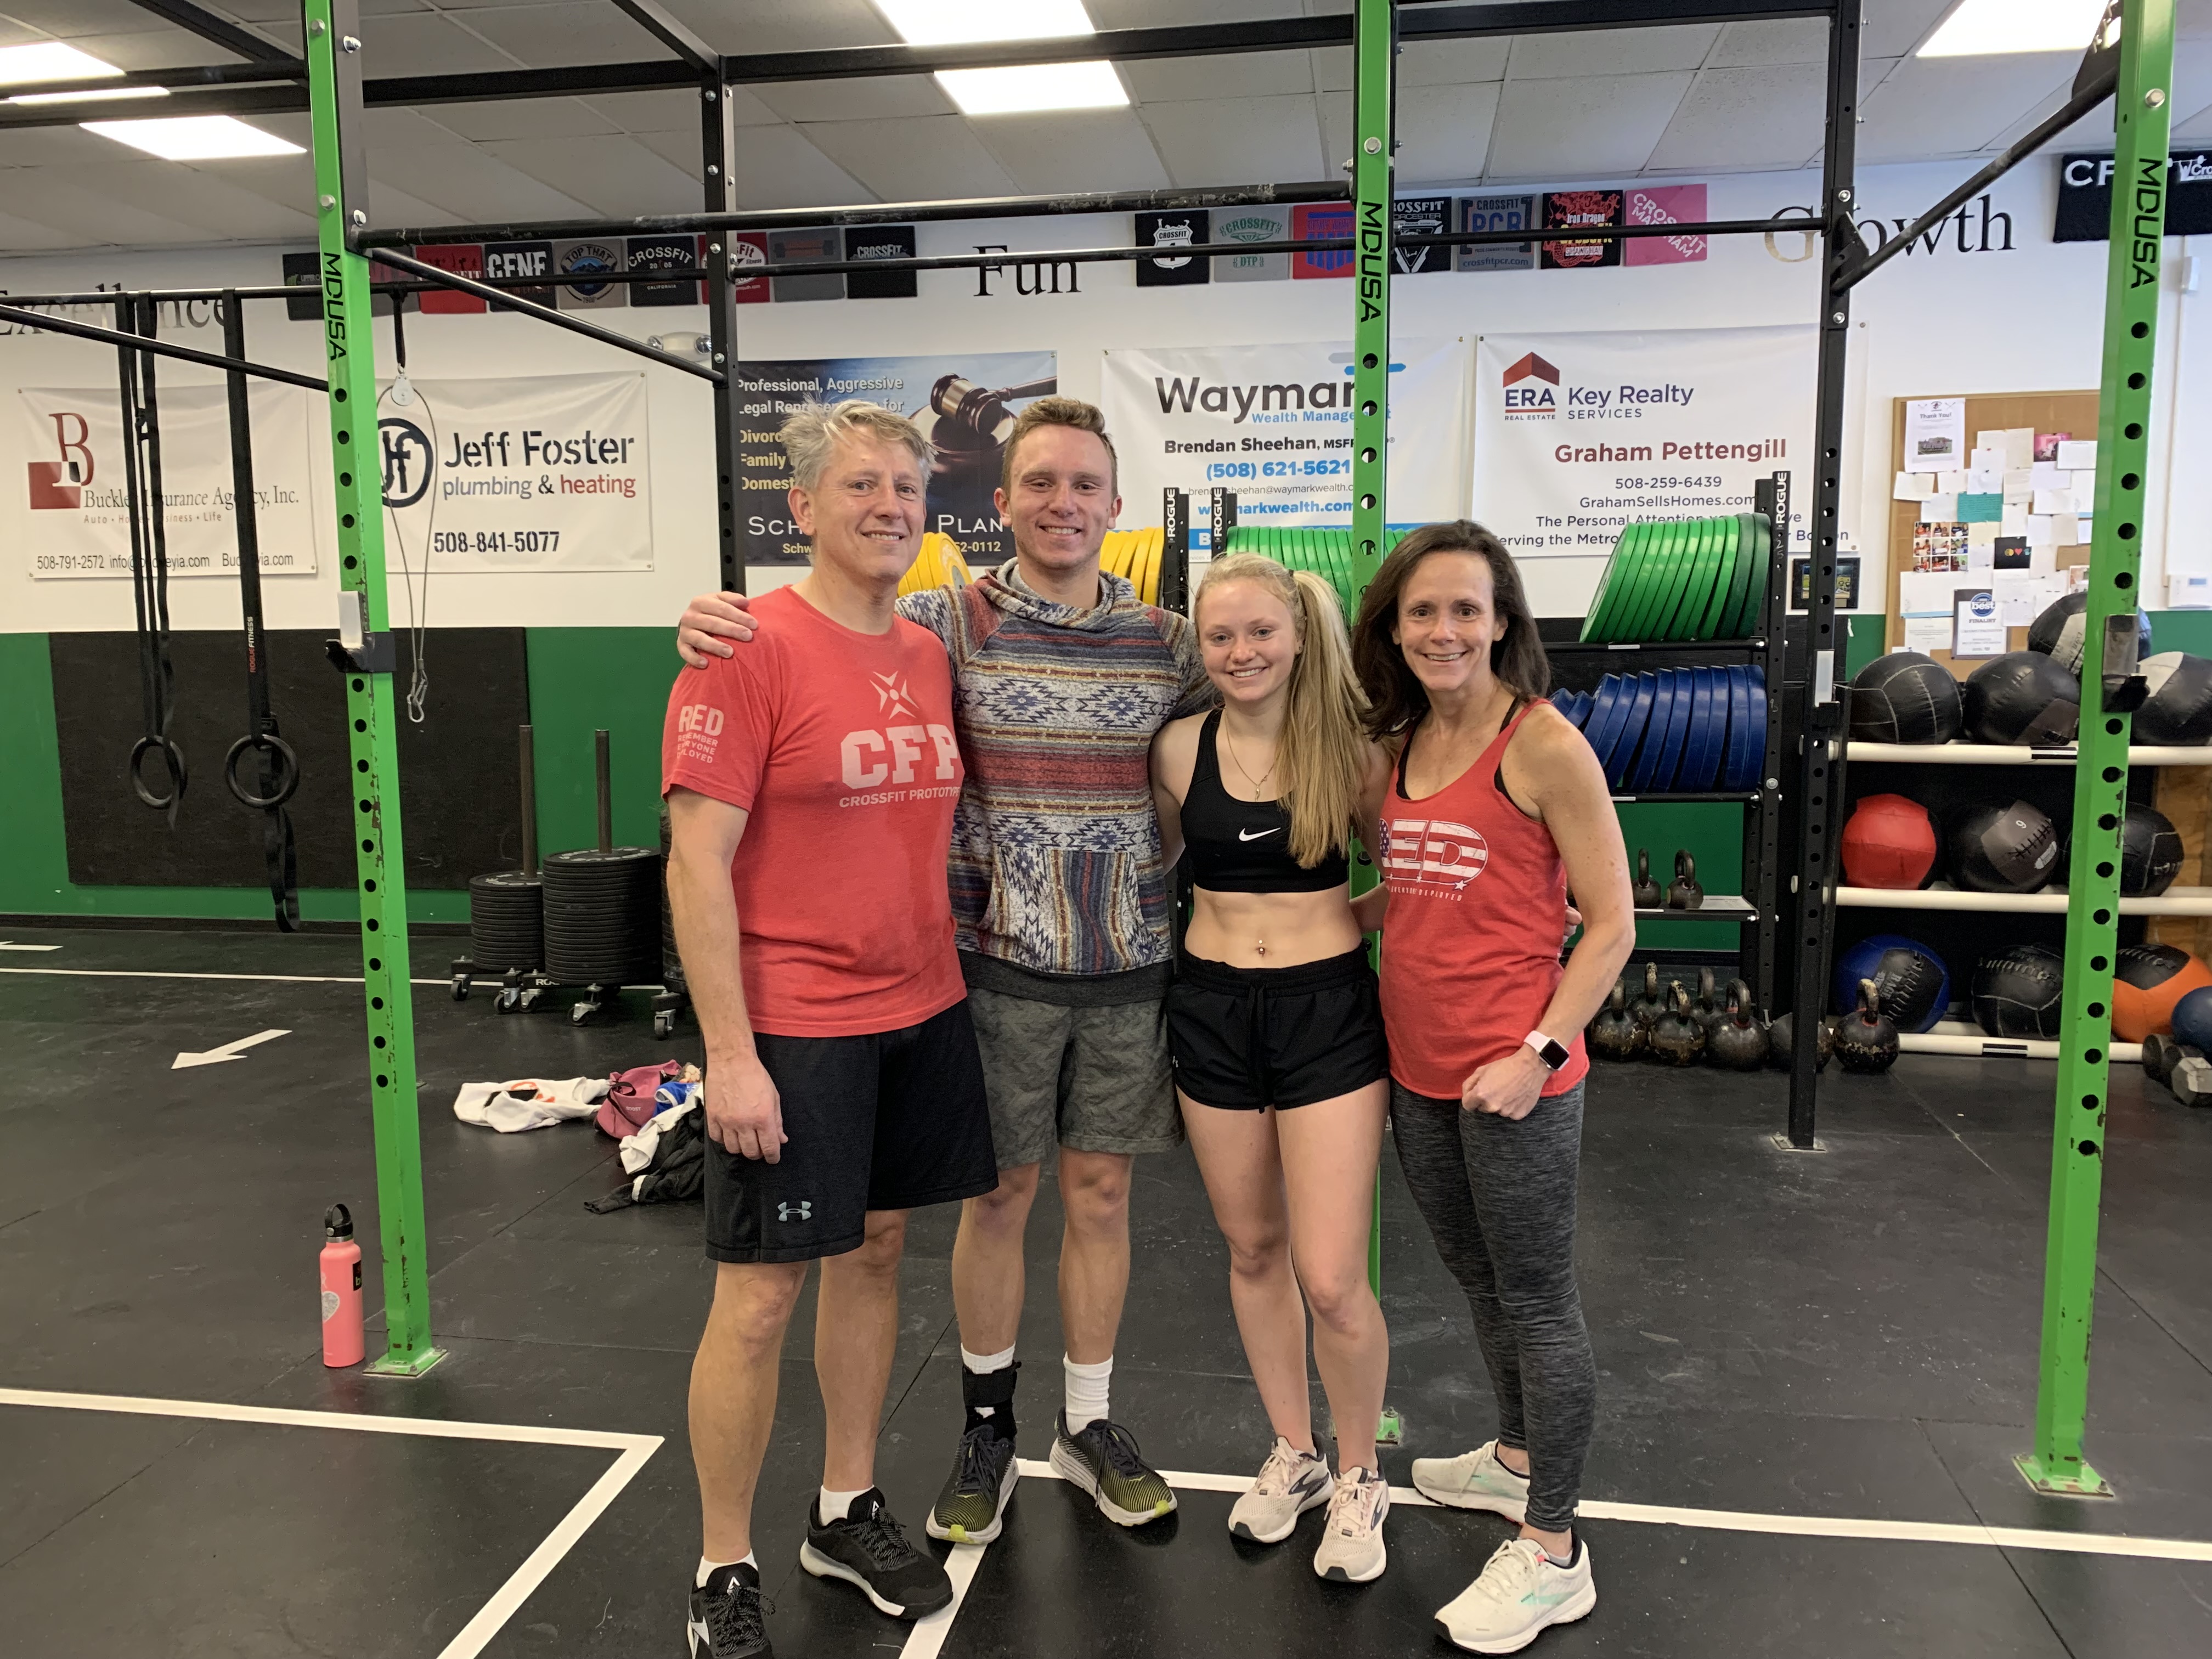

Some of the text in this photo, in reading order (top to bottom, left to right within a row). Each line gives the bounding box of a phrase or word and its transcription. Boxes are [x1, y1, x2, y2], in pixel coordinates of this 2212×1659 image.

[1476, 198, 1519, 210] CROSSFIT
[1225, 218, 1277, 233] CROSSFIT
[1764, 194, 2017, 263] Gowth
[2131, 157, 2163, 289] MDUSA
[629, 246, 692, 267] CROSSFIT
[1360, 201, 1381, 323] MDUSA
[1463, 257, 1528, 268] crossfitpcr.com
[973, 245, 1082, 297] Fun
[321, 252, 348, 360] MDUSA
[827, 377, 904, 393] Aggressive
[1505, 384, 1694, 408] ERA Key Realty
[884, 399, 904, 412] for
[1155, 376, 1355, 424] Waymar
[1252, 413, 1298, 424] Wealth
[1568, 409, 1642, 419] SERVICES
[443, 430, 635, 468] Jeff Foster
[1165, 440, 1235, 454] Brendan
[1241, 437, 1320, 451] Sheehan,
[1555, 439, 1786, 463] Graham Pettengill
[1206, 459, 1351, 481] (508) 621-5621
[443, 474, 636, 500] plumbing & heating
[1615, 476, 1722, 489] 508-259-6439
[83, 489, 138, 508] Buckle
[273, 485, 300, 504] Inc.
[1776, 472, 1787, 523] ROGUE
[84, 515, 107, 524] Auto
[204, 512, 222, 521] Life
[1167, 488, 1175, 537] ROGUE
[1214, 488, 1222, 537] ROGUE
[1536, 516, 1561, 527] The
[1568, 515, 1629, 526] Personal
[433, 531, 560, 553] 508-841-5077
[1549, 534, 1572, 545] the
[1577, 534, 1618, 544] Metro
[37, 555, 104, 569] 508-791-2572
[679, 704, 724, 736] RED
[840, 724, 958, 789] CFP
[839, 791, 906, 808] CROSSFIT
